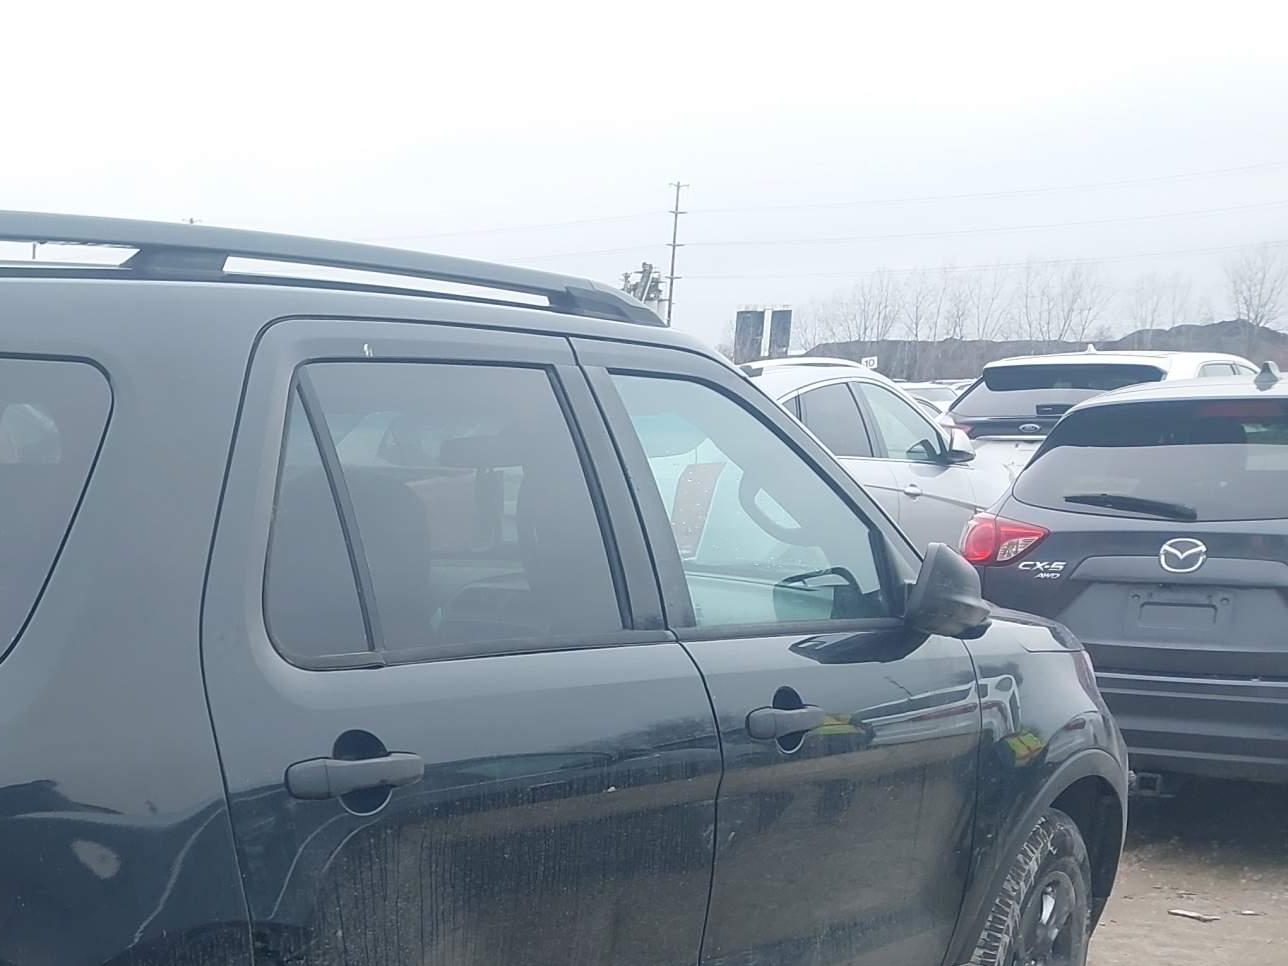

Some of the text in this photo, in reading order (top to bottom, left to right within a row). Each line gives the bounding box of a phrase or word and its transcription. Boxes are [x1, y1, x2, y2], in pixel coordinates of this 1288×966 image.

[864, 358, 876, 368] 10
[1018, 561, 1067, 572] CX-5
[1034, 572, 1062, 580] AWD
